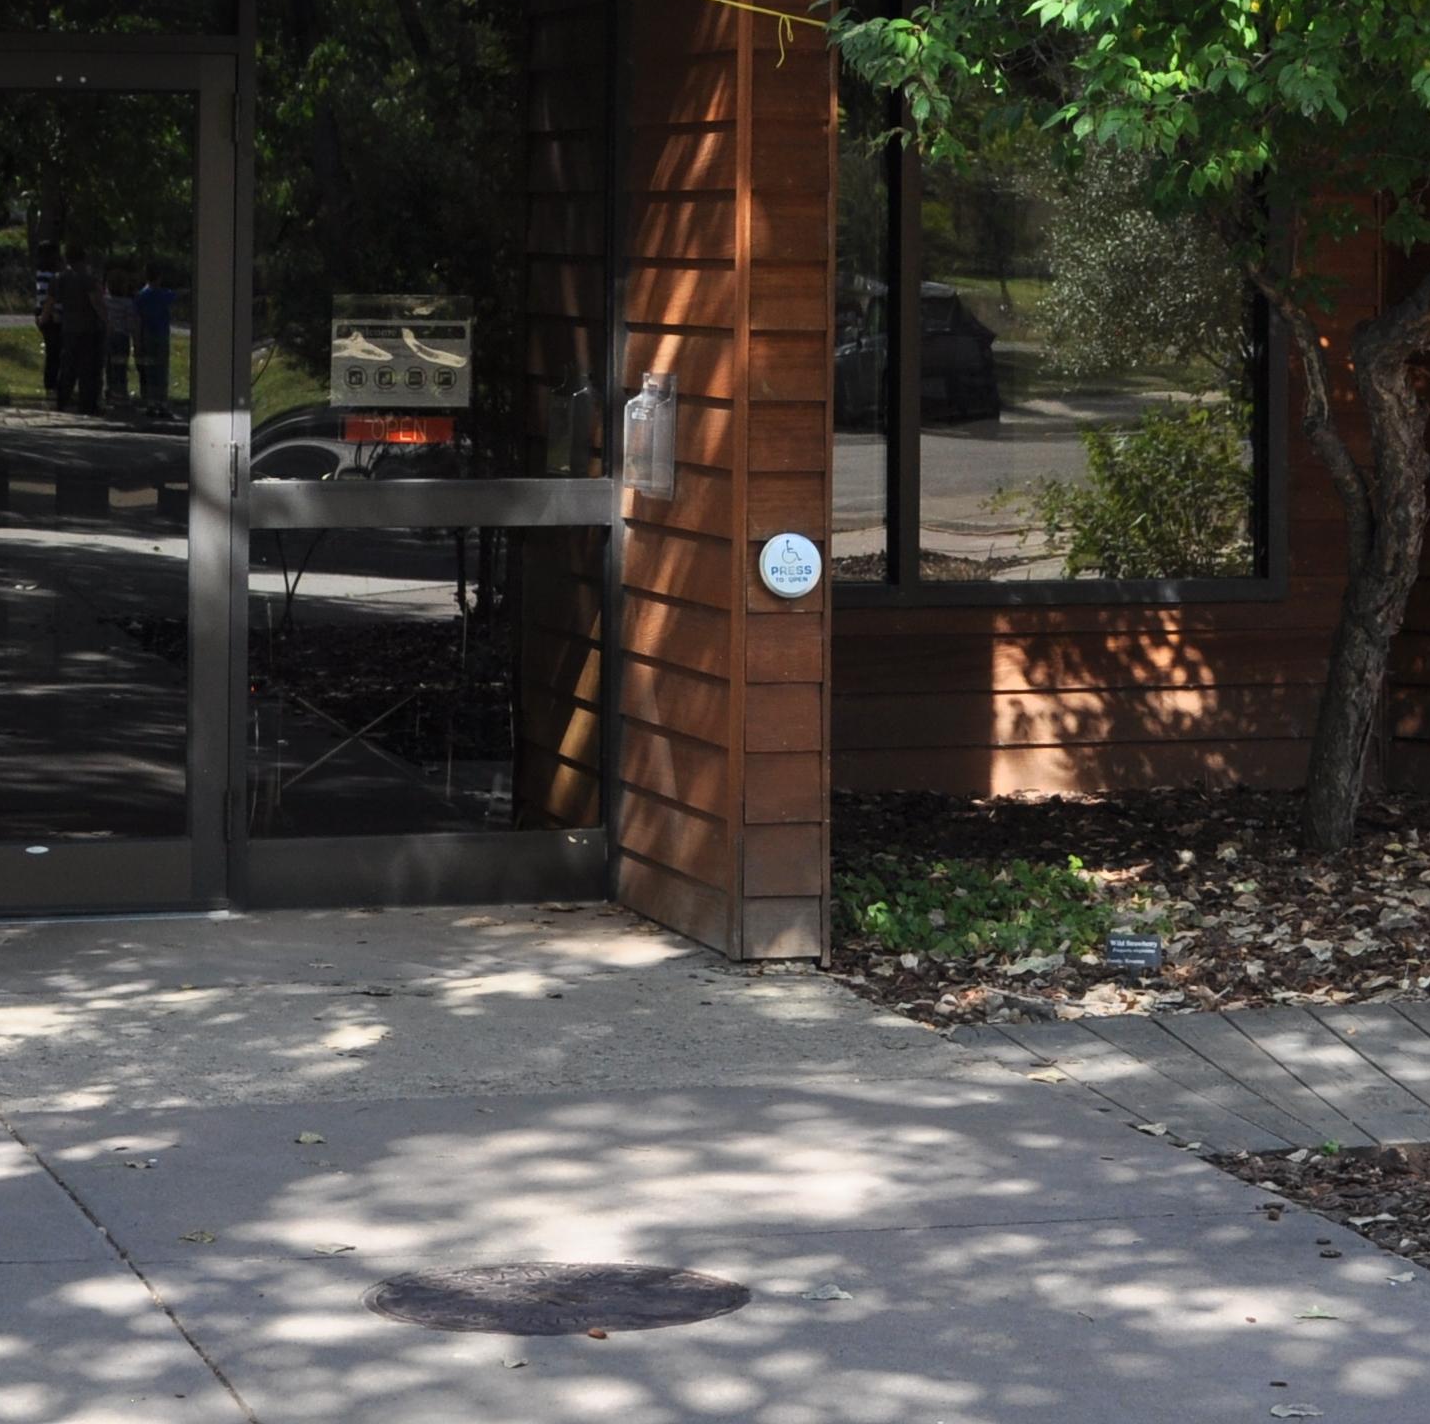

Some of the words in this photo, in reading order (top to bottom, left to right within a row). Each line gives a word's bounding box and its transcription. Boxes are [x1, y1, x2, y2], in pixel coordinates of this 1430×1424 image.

[371, 418, 427, 443] OPEN
[771, 565, 812, 576] PRESS
[788, 576, 809, 584] OPEN
